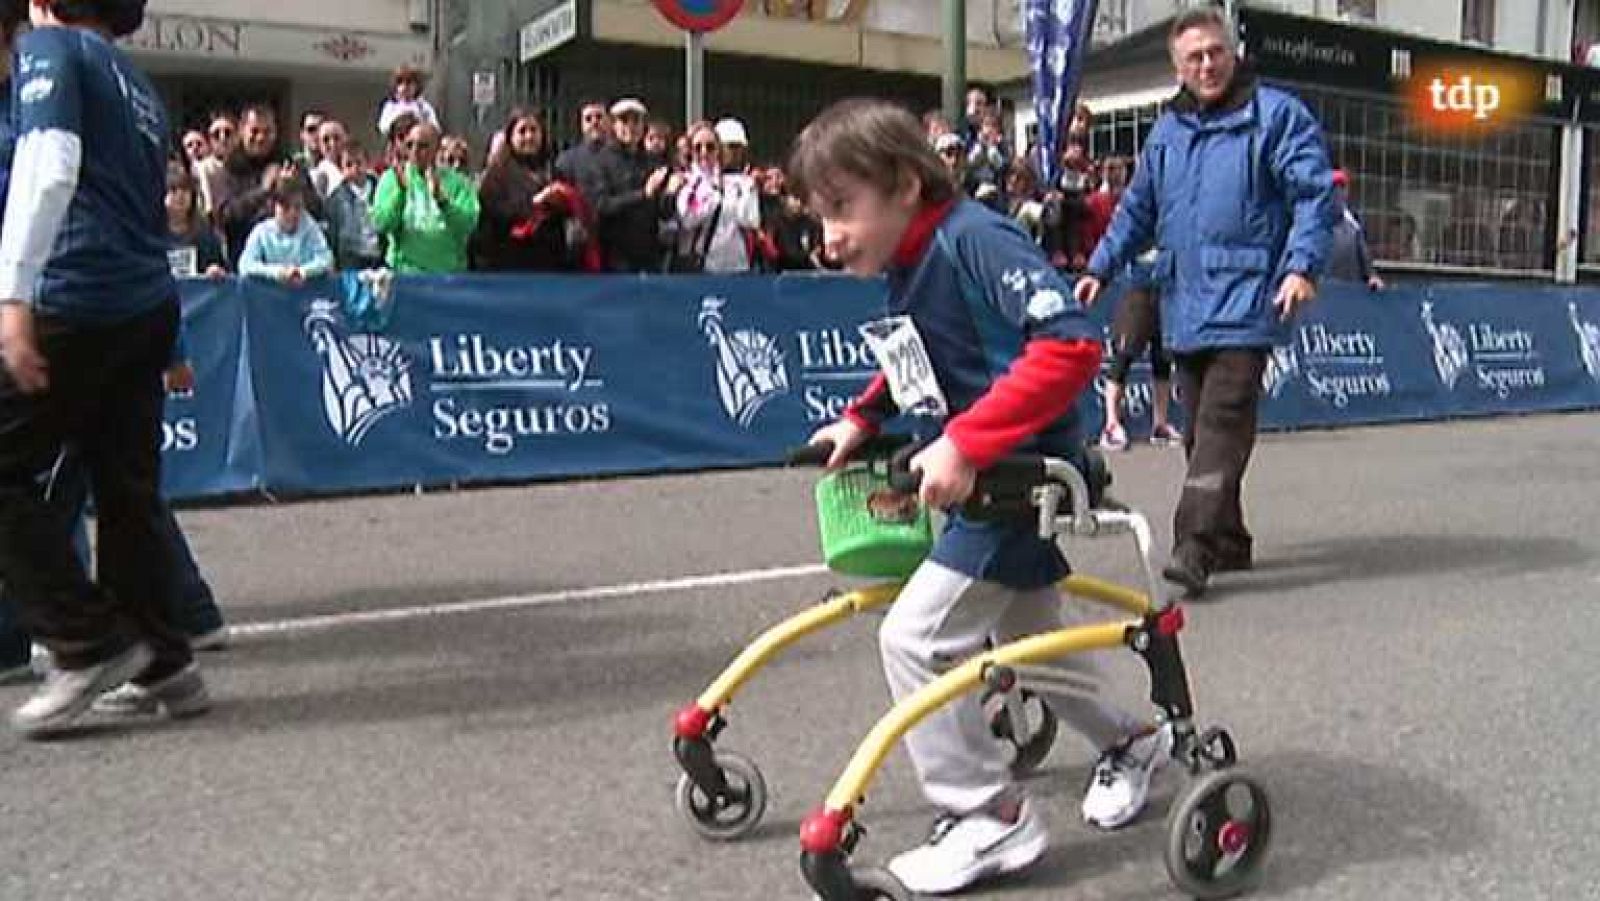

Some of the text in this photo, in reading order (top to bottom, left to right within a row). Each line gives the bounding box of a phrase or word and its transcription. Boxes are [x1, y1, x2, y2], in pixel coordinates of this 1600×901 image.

[430, 333, 593, 392] Liberty
[797, 328, 879, 368] Libe
[1300, 324, 1375, 365] Liberty
[1468, 324, 1534, 361] Liberty
[1307, 369, 1391, 408] Seguros
[1476, 364, 1544, 399] Seguros
[432, 397, 610, 455] Seguros
